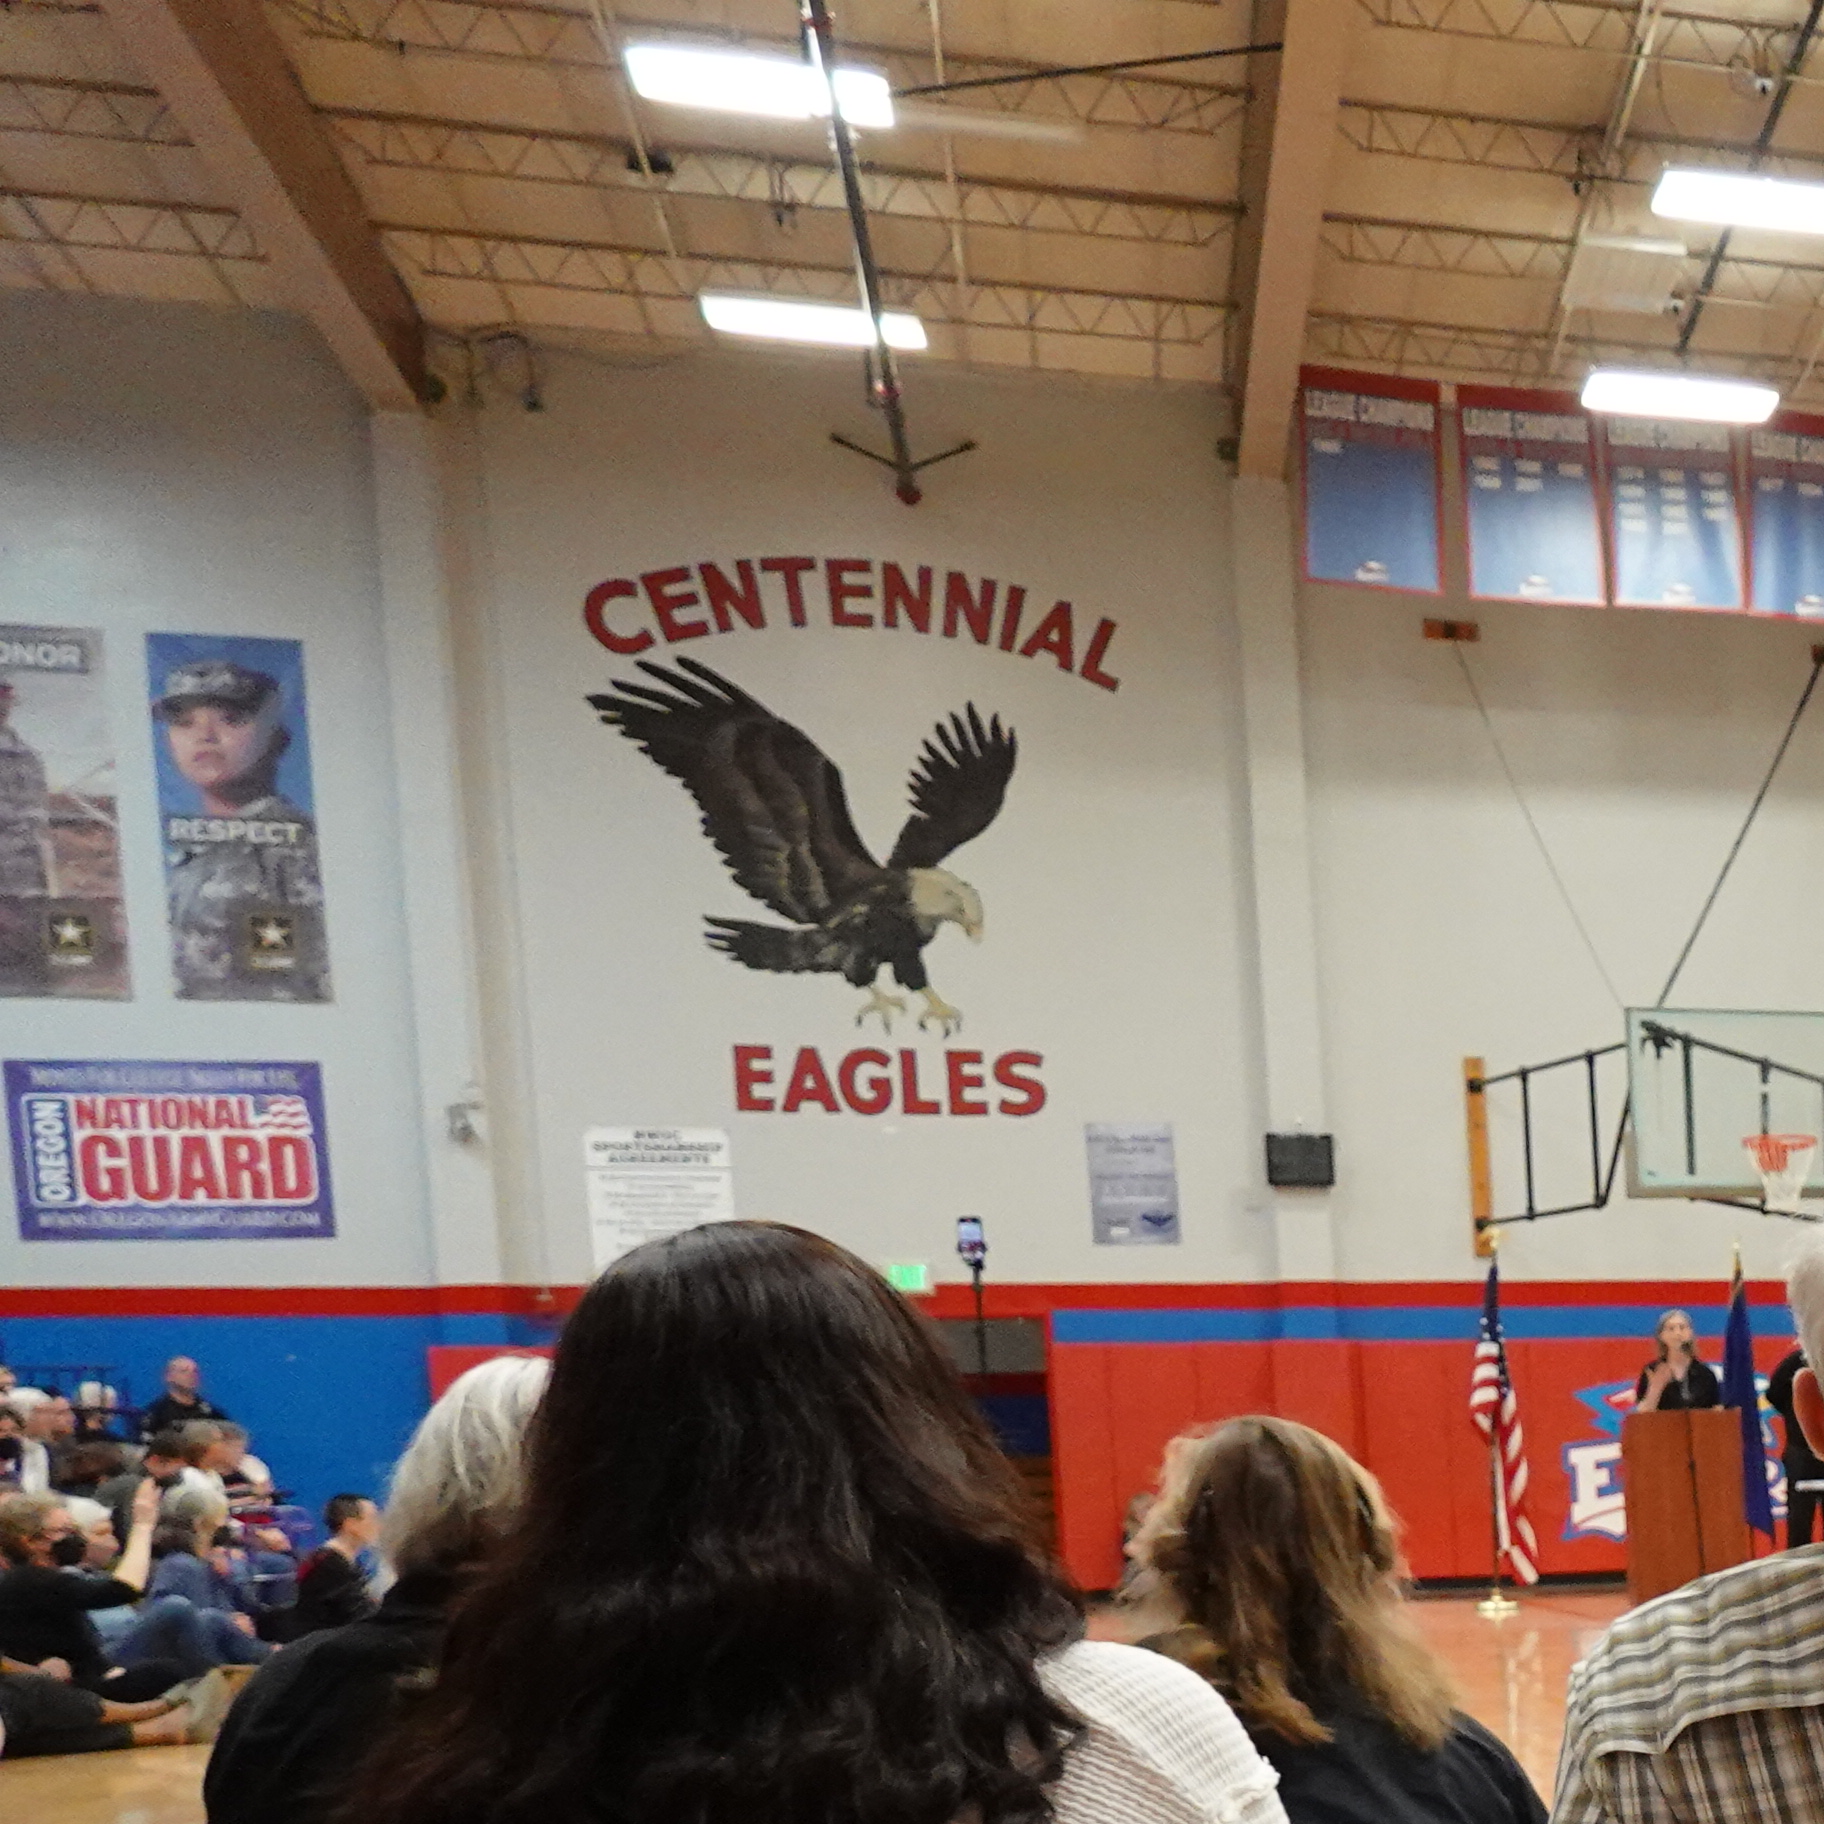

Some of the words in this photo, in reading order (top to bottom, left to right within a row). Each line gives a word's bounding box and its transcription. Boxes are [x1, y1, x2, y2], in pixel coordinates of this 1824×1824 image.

[583, 556, 1120, 692] CENTENNIAL
[169, 818, 300, 844] RESPECT
[75, 1098, 251, 1129] NATIONAL
[733, 1044, 1047, 1116] EAGLES
[32, 1101, 70, 1201] OREGON
[80, 1134, 312, 1201] GUARD
